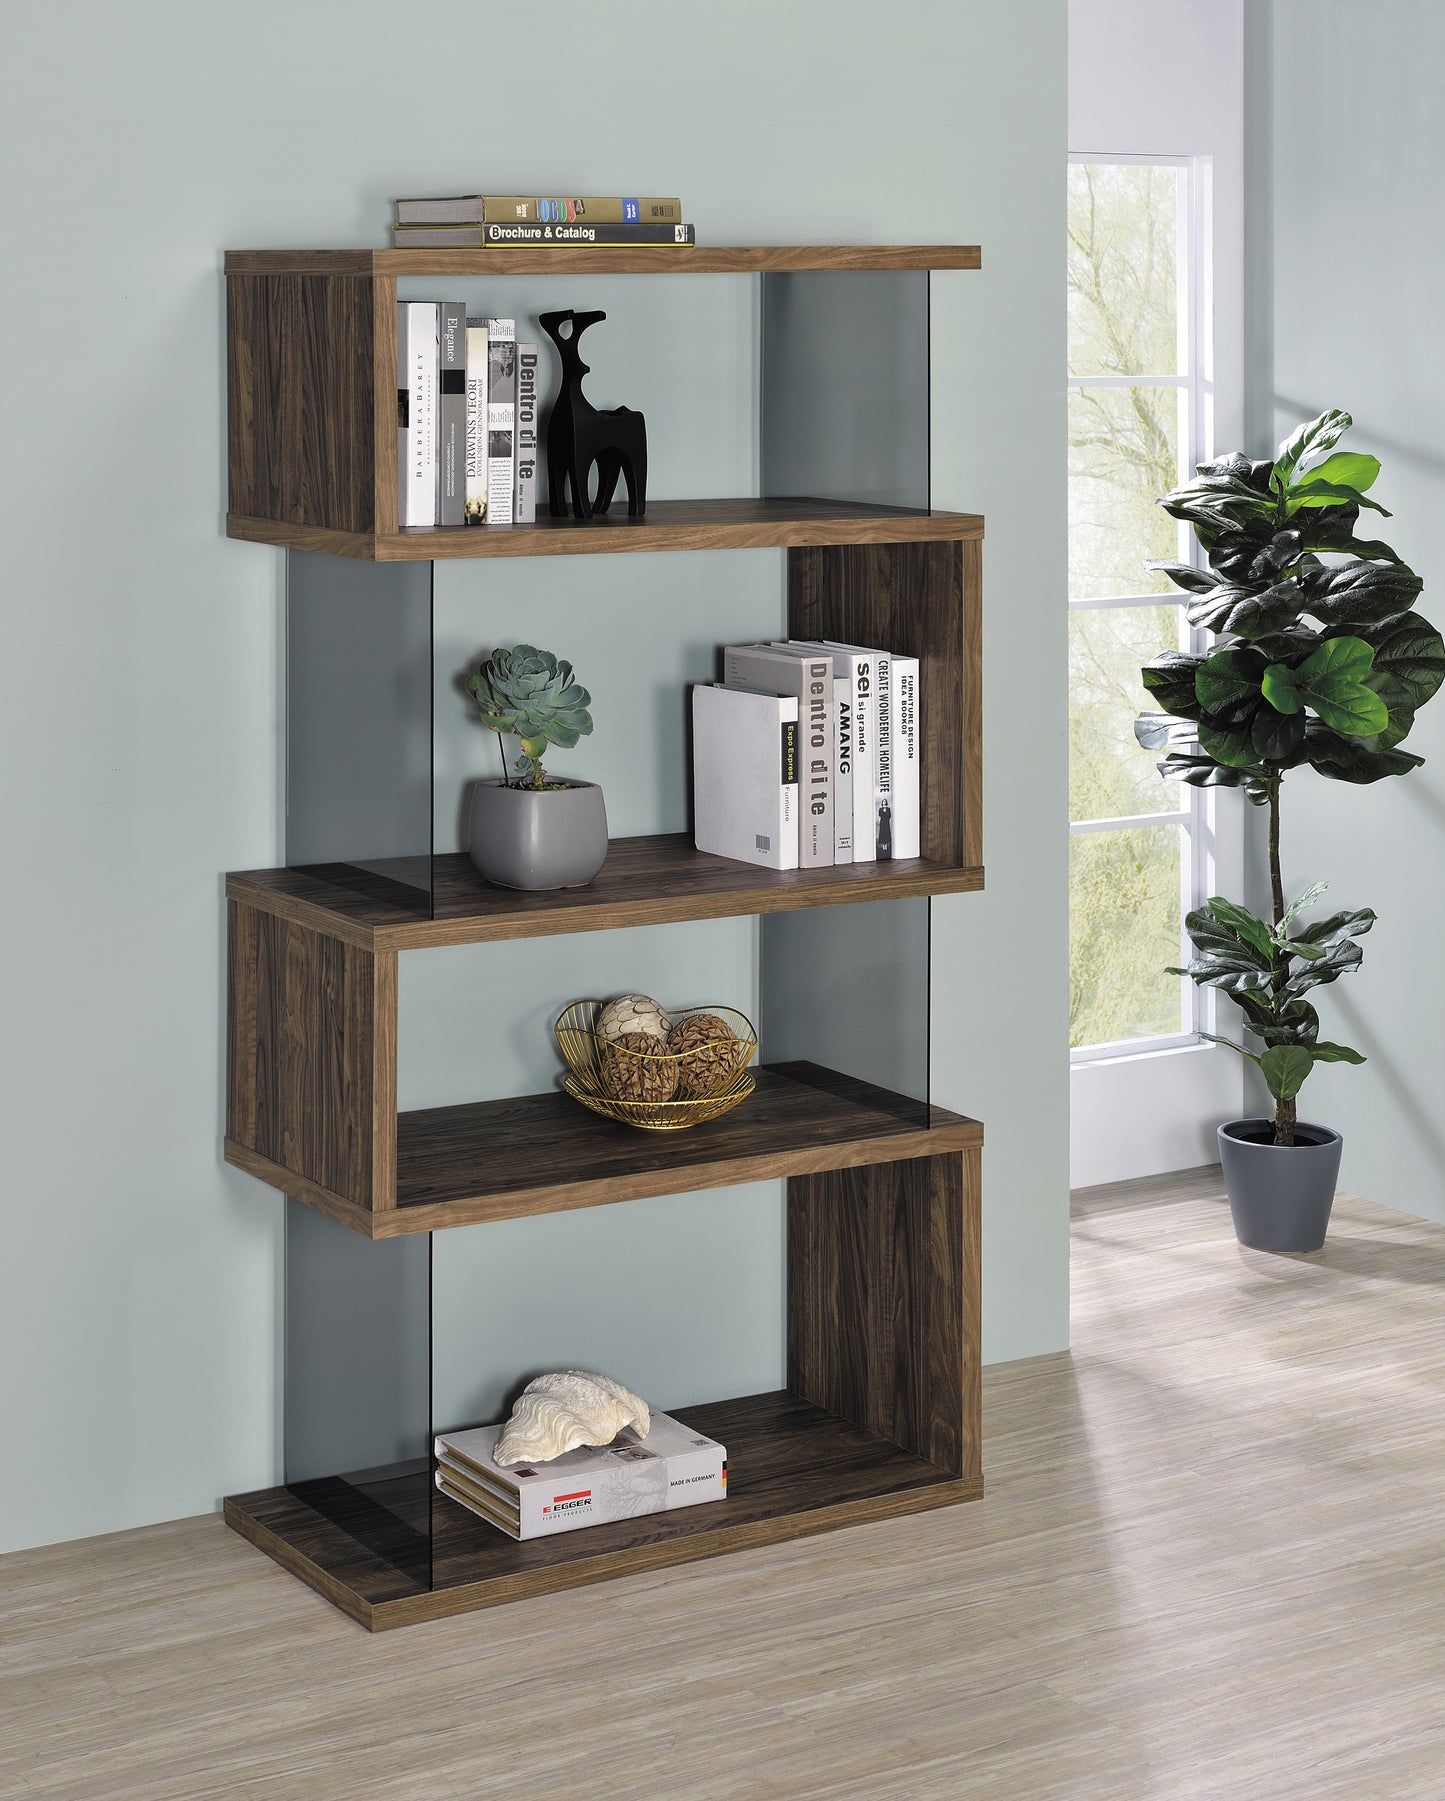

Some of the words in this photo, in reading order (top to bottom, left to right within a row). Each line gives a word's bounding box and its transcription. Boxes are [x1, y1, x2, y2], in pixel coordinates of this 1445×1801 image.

[534, 199, 577, 223] LOGOS
[489, 225, 541, 240] Brochure
[544, 226, 553, 239] &
[555, 226, 595, 241] Catalog
[444, 318, 457, 362] Elegance
[416, 354, 424, 401] BAREY
[519, 354, 538, 423] Dentro
[468, 379, 476, 417] TEORI
[467, 419, 476, 478] DARWINS
[519, 430, 536, 449] di
[519, 459, 536, 479] te
[857, 663, 873, 699] sei
[878, 660, 888, 691] CREATE
[810, 663, 828, 749] Dentro
[858, 701, 865, 711] si
[879, 693, 889, 748] WONDERFUL
[839, 702, 850, 775] AMANG
[857, 714, 865, 753] grande
[810, 759, 828, 784] di
[879, 750, 889, 793] HOMELIFE
[810, 791, 828, 816] te
[670, 1479, 684, 1487] MADE
[691, 1473, 716, 1483] GERMANY
[542, 1513, 560, 1521] FLOOR
[564, 1507, 593, 1517] PRODUCTS
[553, 1498, 592, 1511] EGGER
